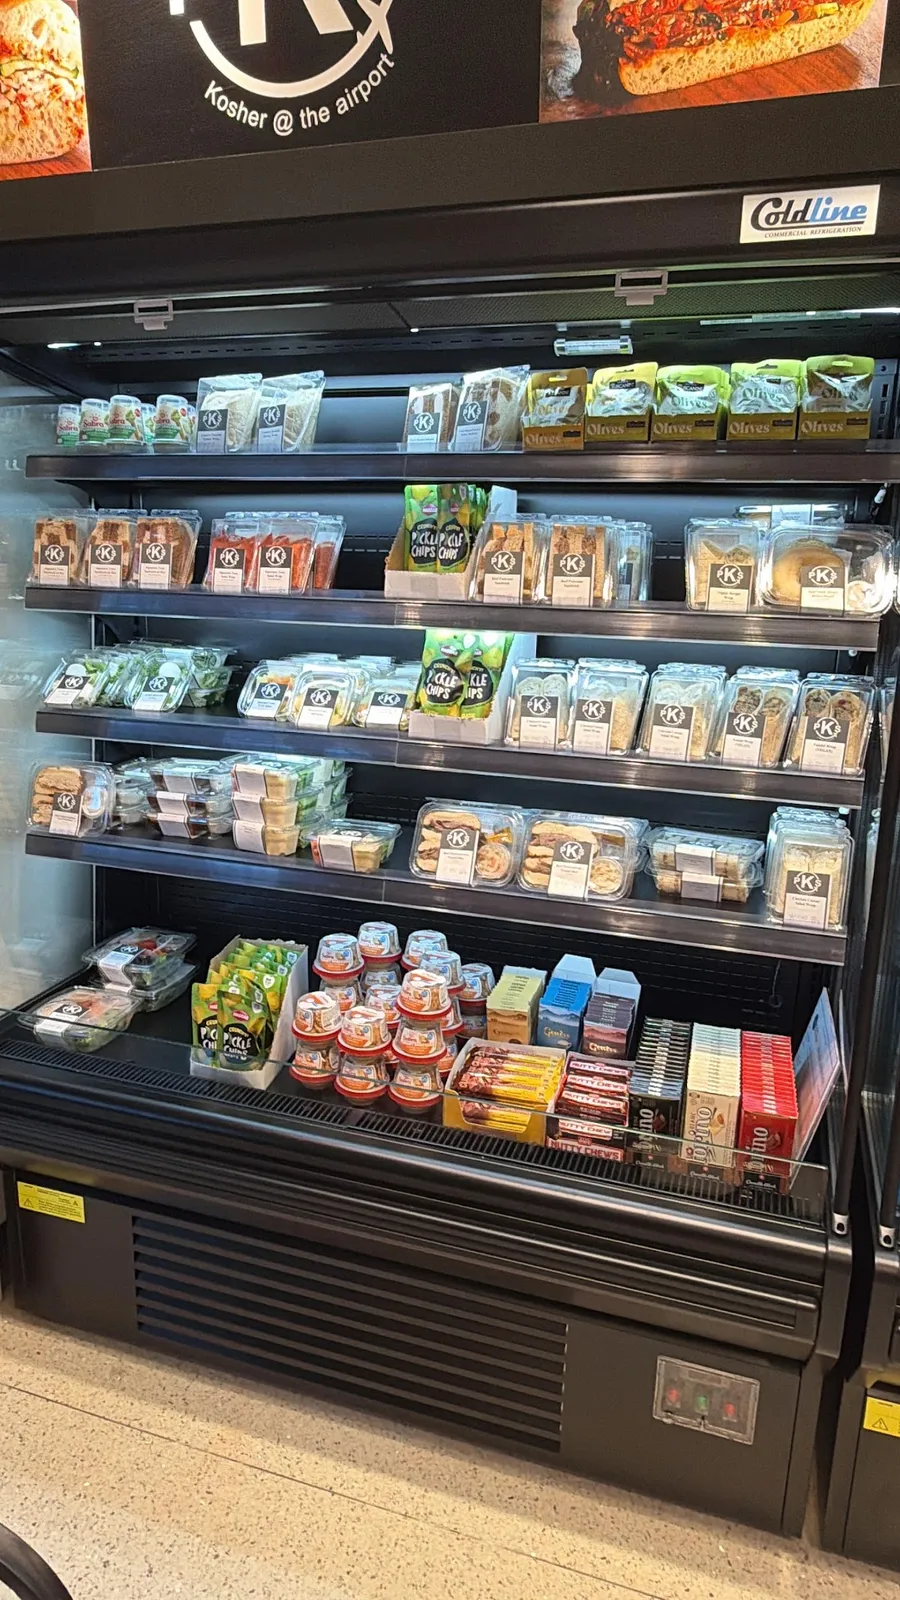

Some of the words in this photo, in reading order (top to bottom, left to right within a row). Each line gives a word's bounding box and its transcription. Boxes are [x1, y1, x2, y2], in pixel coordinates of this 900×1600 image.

[204, 80, 267, 129] Kosher
[273, 110, 294, 136] @
[299, 107, 331, 129] the
[335, 53, 395, 115] airport
[750, 197, 868, 231] Coldline
[764, 230, 807, 238] COMMERCIAL
[810, 227, 862, 235] REFRIGERATION
[587, 423, 625, 435] Olives
[653, 422, 692, 434] Olives
[730, 421, 770, 434] Olives
[801, 420, 844, 432] Olives
[525, 432, 561, 445] Olives
[411, 531, 438, 545] PICKL
[411, 545, 436, 558] CHIPS
[470, 673, 488, 686] KLE
[426, 684, 451, 699] CHIPS
[468, 687, 483, 699] IPS
[201, 1027, 217, 1040] PIC
[203, 1040, 217, 1049] CHI
[224, 1033, 251, 1049] PICKLE
[569, 1076, 596, 1085] NUTTY
[597, 1080, 625, 1090] CHEWS
[551, 1140, 583, 1152] NUTTY
[584, 1148, 620, 1160] CHEWS
